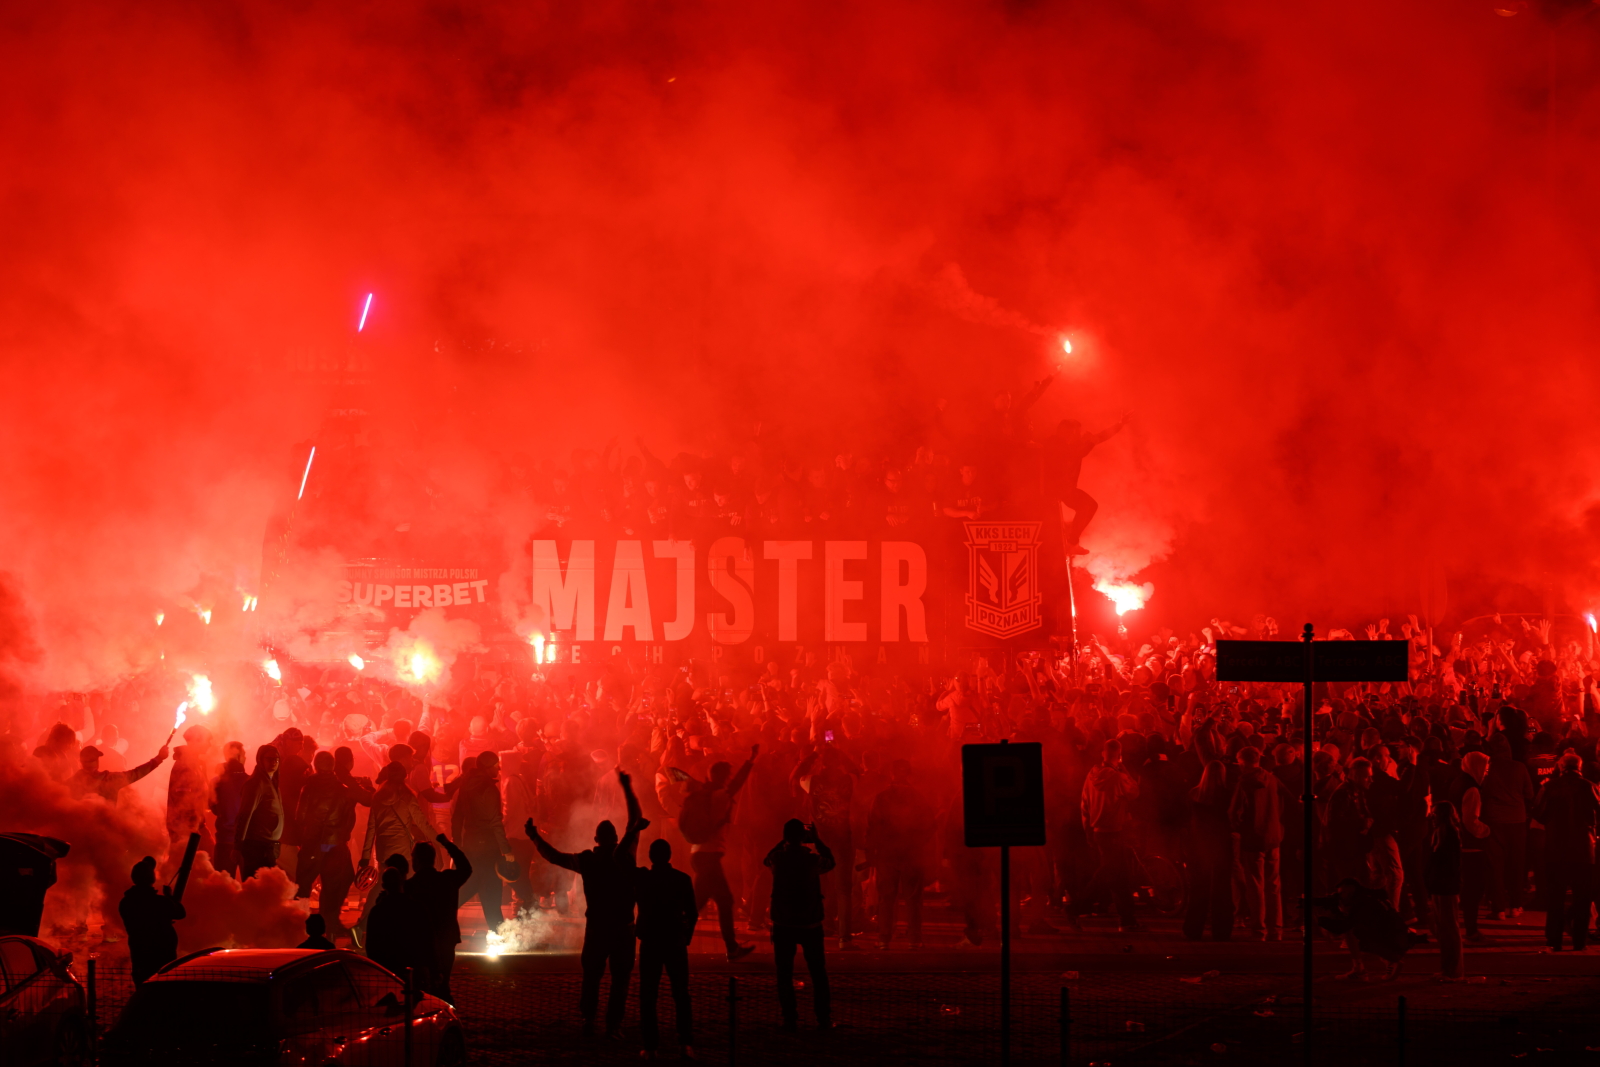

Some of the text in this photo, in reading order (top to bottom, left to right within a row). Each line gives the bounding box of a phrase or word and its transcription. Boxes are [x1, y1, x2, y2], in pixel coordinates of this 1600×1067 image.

[975, 527, 1031, 539] KKS LECH
[993, 543, 1013, 551] 1922
[374, 568, 412, 580] SPONSOR
[413, 568, 449, 580] MISTRZA
[450, 568, 479, 580] POLSKI
[333, 579, 489, 608] SUPERBET
[531, 536, 929, 645] MAJSTER
[980, 607, 1028, 628] POZNAŃ
[550, 645, 663, 664] ECH
[1222, 655, 1301, 668] Tercetu ABC
[1318, 655, 1403, 667] Tercetu ABC
[432, 764, 460, 788] 12
[1537, 767, 1554, 775] RAM
[982, 756, 1026, 816] P
